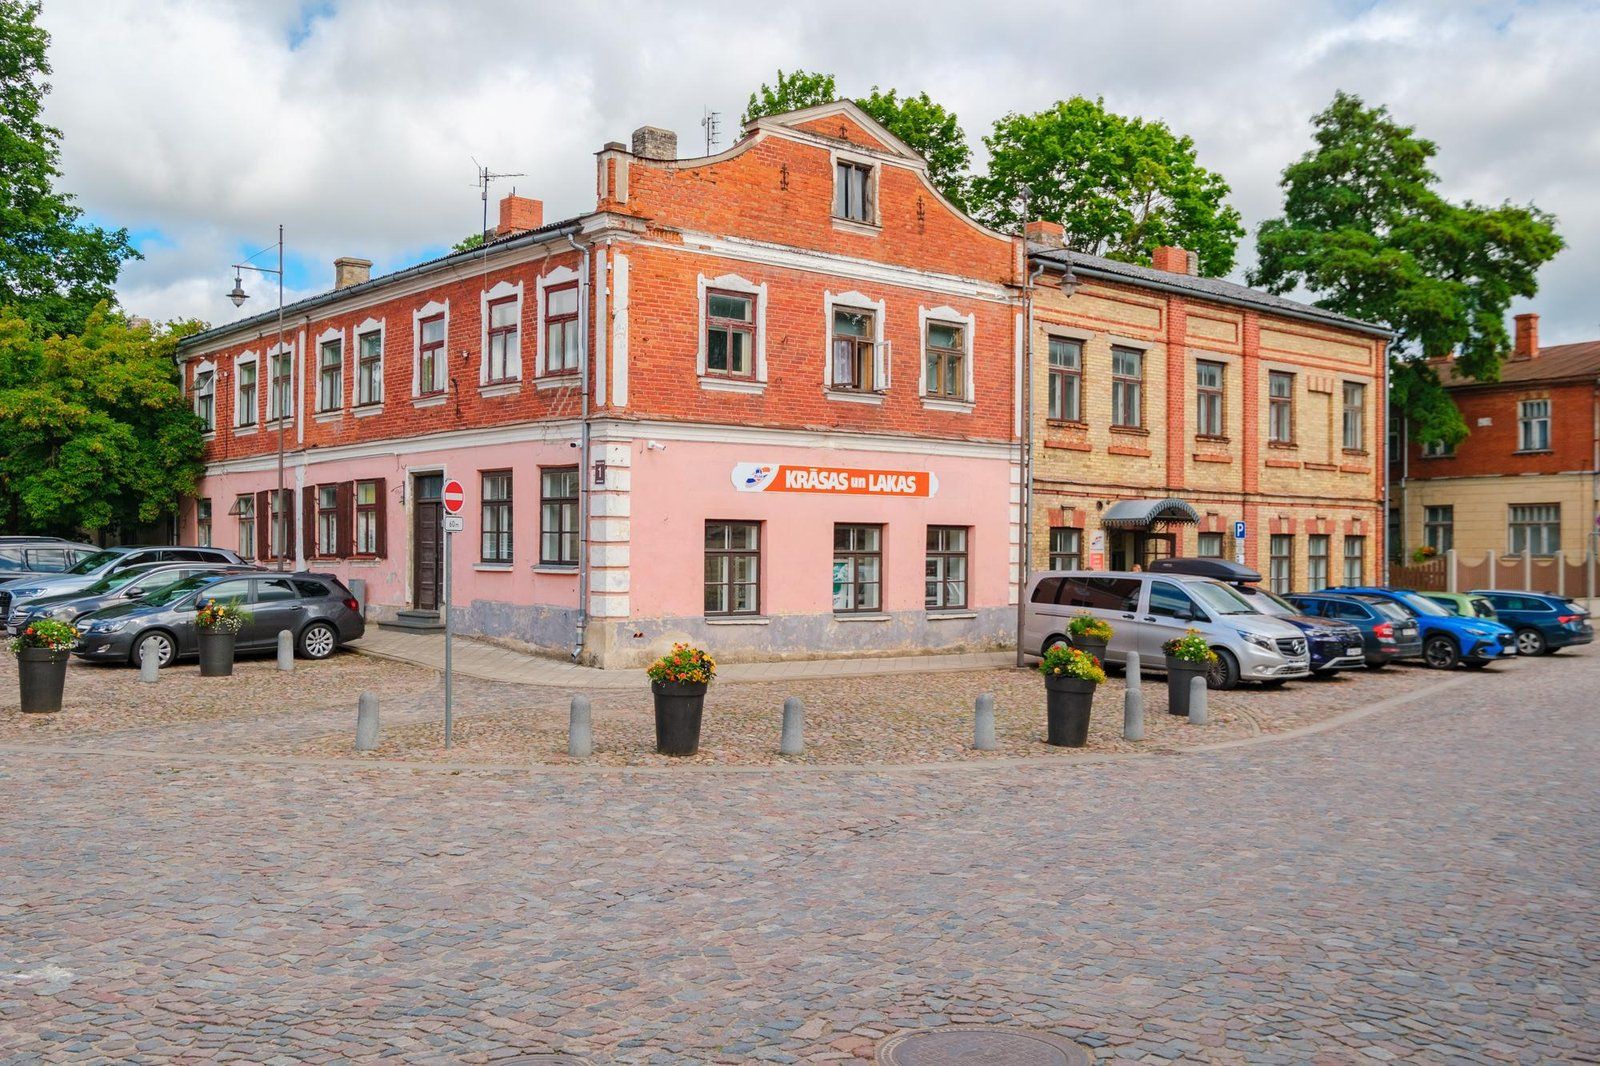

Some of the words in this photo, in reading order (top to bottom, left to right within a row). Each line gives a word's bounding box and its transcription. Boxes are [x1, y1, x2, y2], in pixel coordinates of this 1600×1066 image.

[597, 466, 602, 478] 1
[785, 468, 848, 489] KRĀSAS
[850, 476, 866, 488] un
[869, 474, 916, 493] LAKAS
[1236, 523, 1244, 537] P
